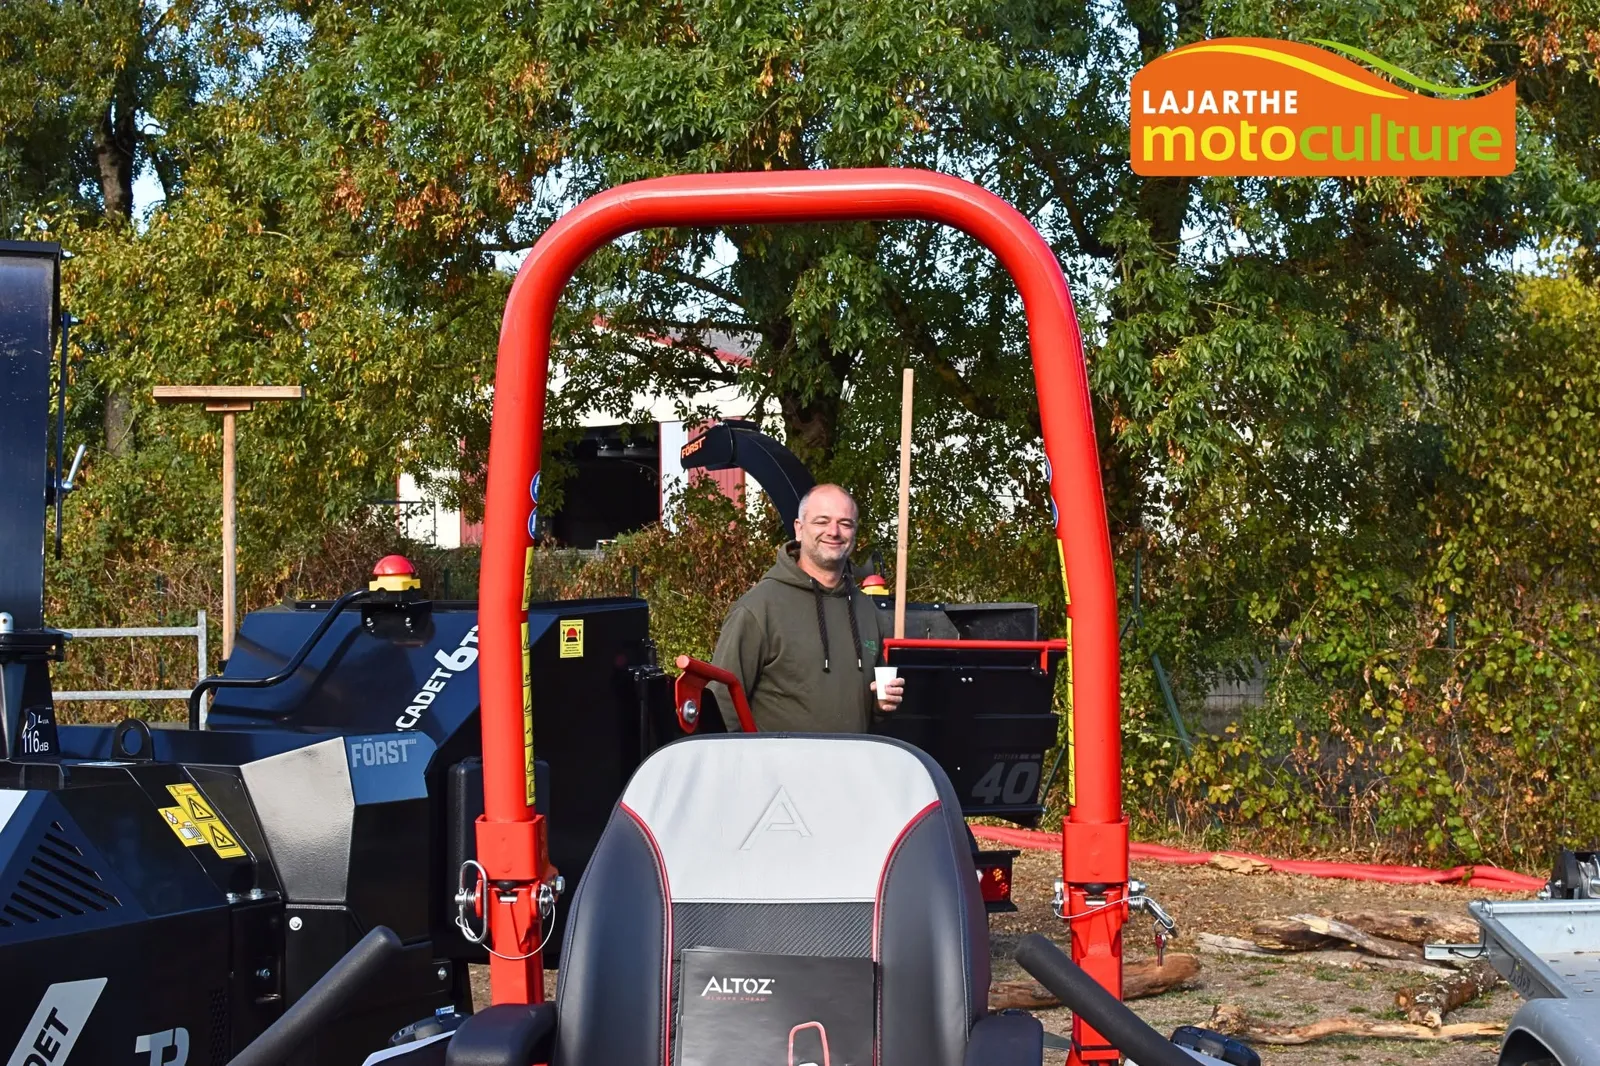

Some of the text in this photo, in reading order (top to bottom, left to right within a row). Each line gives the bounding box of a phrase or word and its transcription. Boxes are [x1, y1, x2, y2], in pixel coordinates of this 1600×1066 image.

[681, 436, 706, 459] FÖRST
[395, 667, 453, 729] CADET
[351, 738, 408, 768] FÖRST
[971, 761, 1040, 804] 40
[701, 975, 773, 997] ALTOZ
